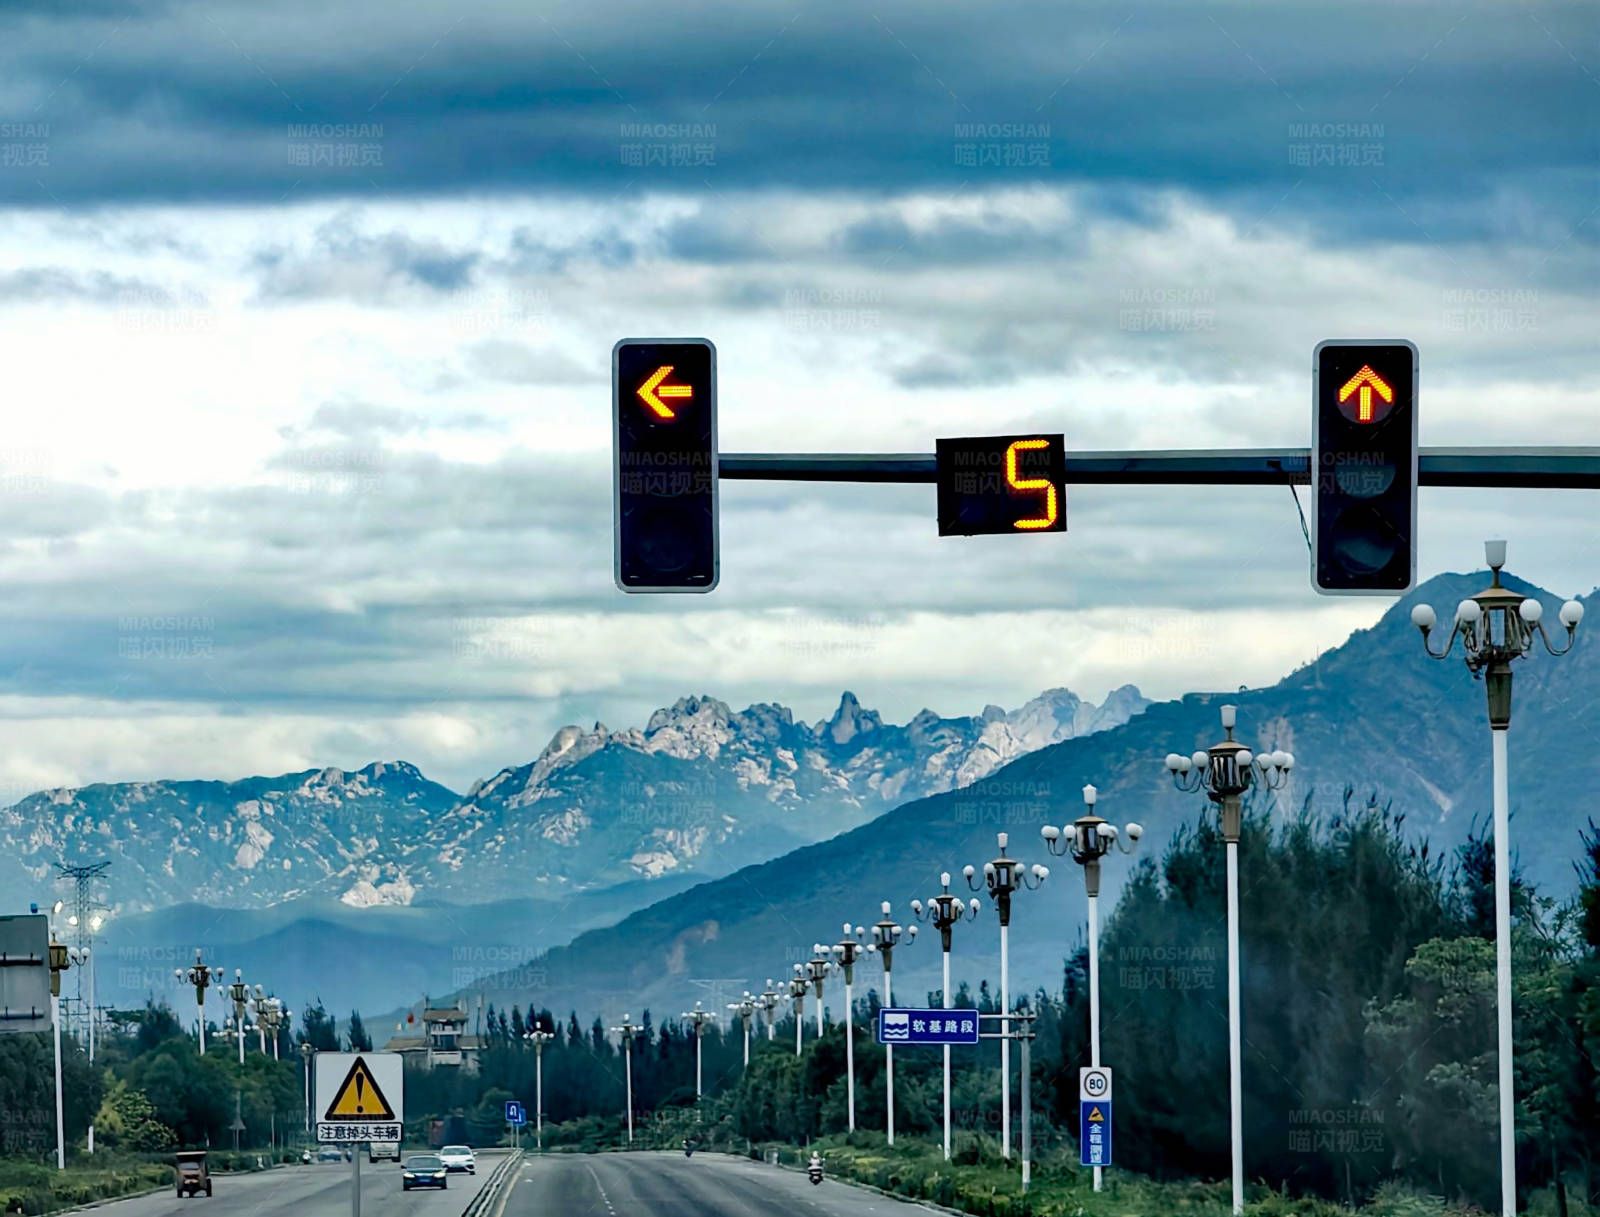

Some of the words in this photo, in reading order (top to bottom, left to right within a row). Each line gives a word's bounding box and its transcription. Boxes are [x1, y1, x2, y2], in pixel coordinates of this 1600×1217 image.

[1006, 439, 1056, 529] 5
[912, 1018, 974, 1034] 软基路段
[1089, 1078, 1104, 1090] 80
[320, 1125, 399, 1140] 注意掉头车辆
